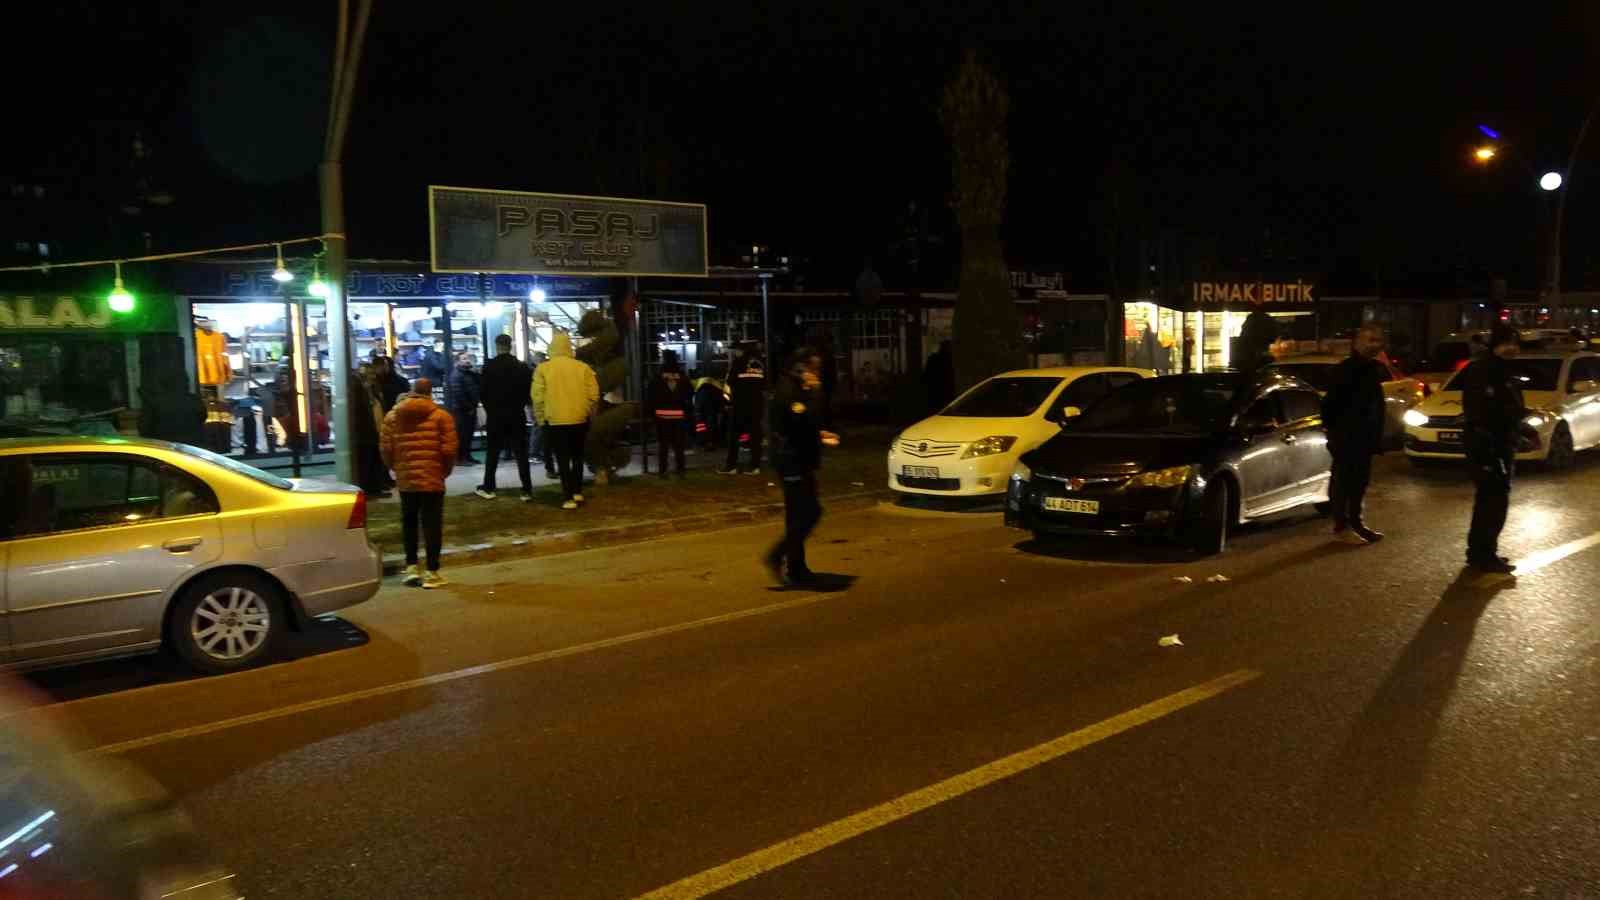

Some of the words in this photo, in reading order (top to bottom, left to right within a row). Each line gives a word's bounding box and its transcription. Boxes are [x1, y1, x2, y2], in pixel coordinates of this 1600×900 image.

[496, 205, 658, 240] PASAJ
[581, 240, 633, 257] CLUB
[376, 275, 426, 294] KOT
[436, 275, 496, 296] CLUB
[1192, 281, 1253, 302] IRMAK
[1263, 278, 1313, 302] BUTİK
